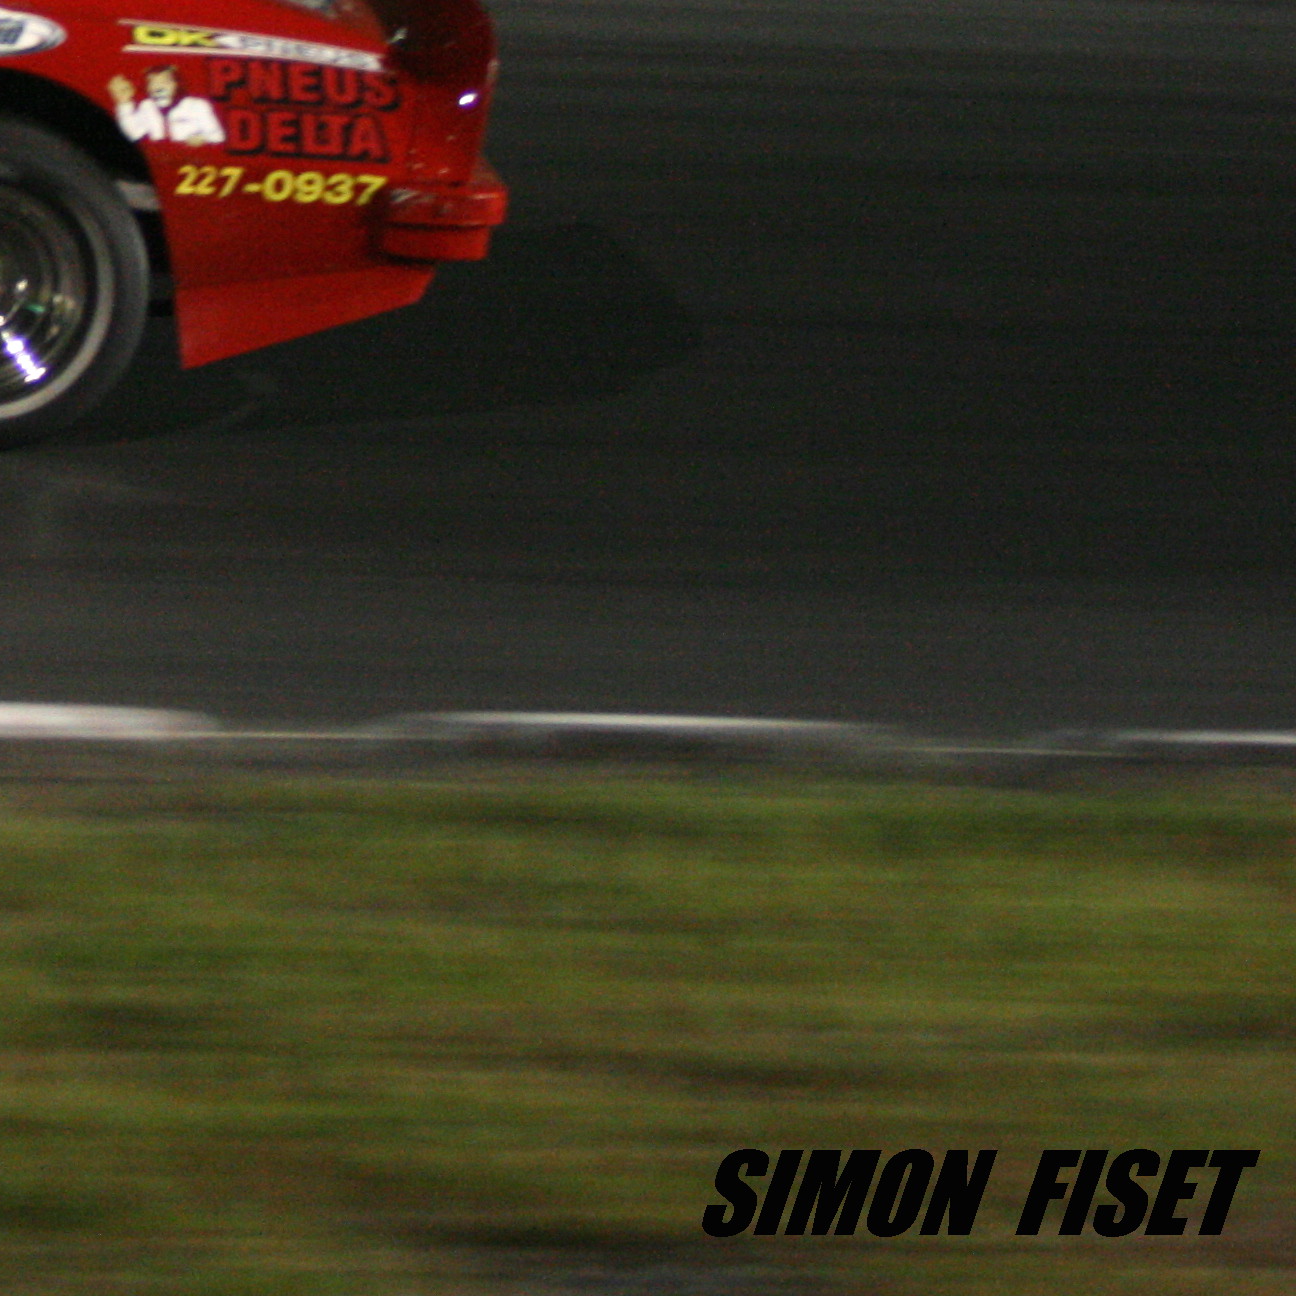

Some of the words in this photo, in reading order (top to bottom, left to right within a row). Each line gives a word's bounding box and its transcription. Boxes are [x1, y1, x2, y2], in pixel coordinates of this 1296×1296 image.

[207, 57, 400, 112] PNEUS
[224, 108, 390, 164] DELTA
[175, 164, 389, 206] 227-0937
